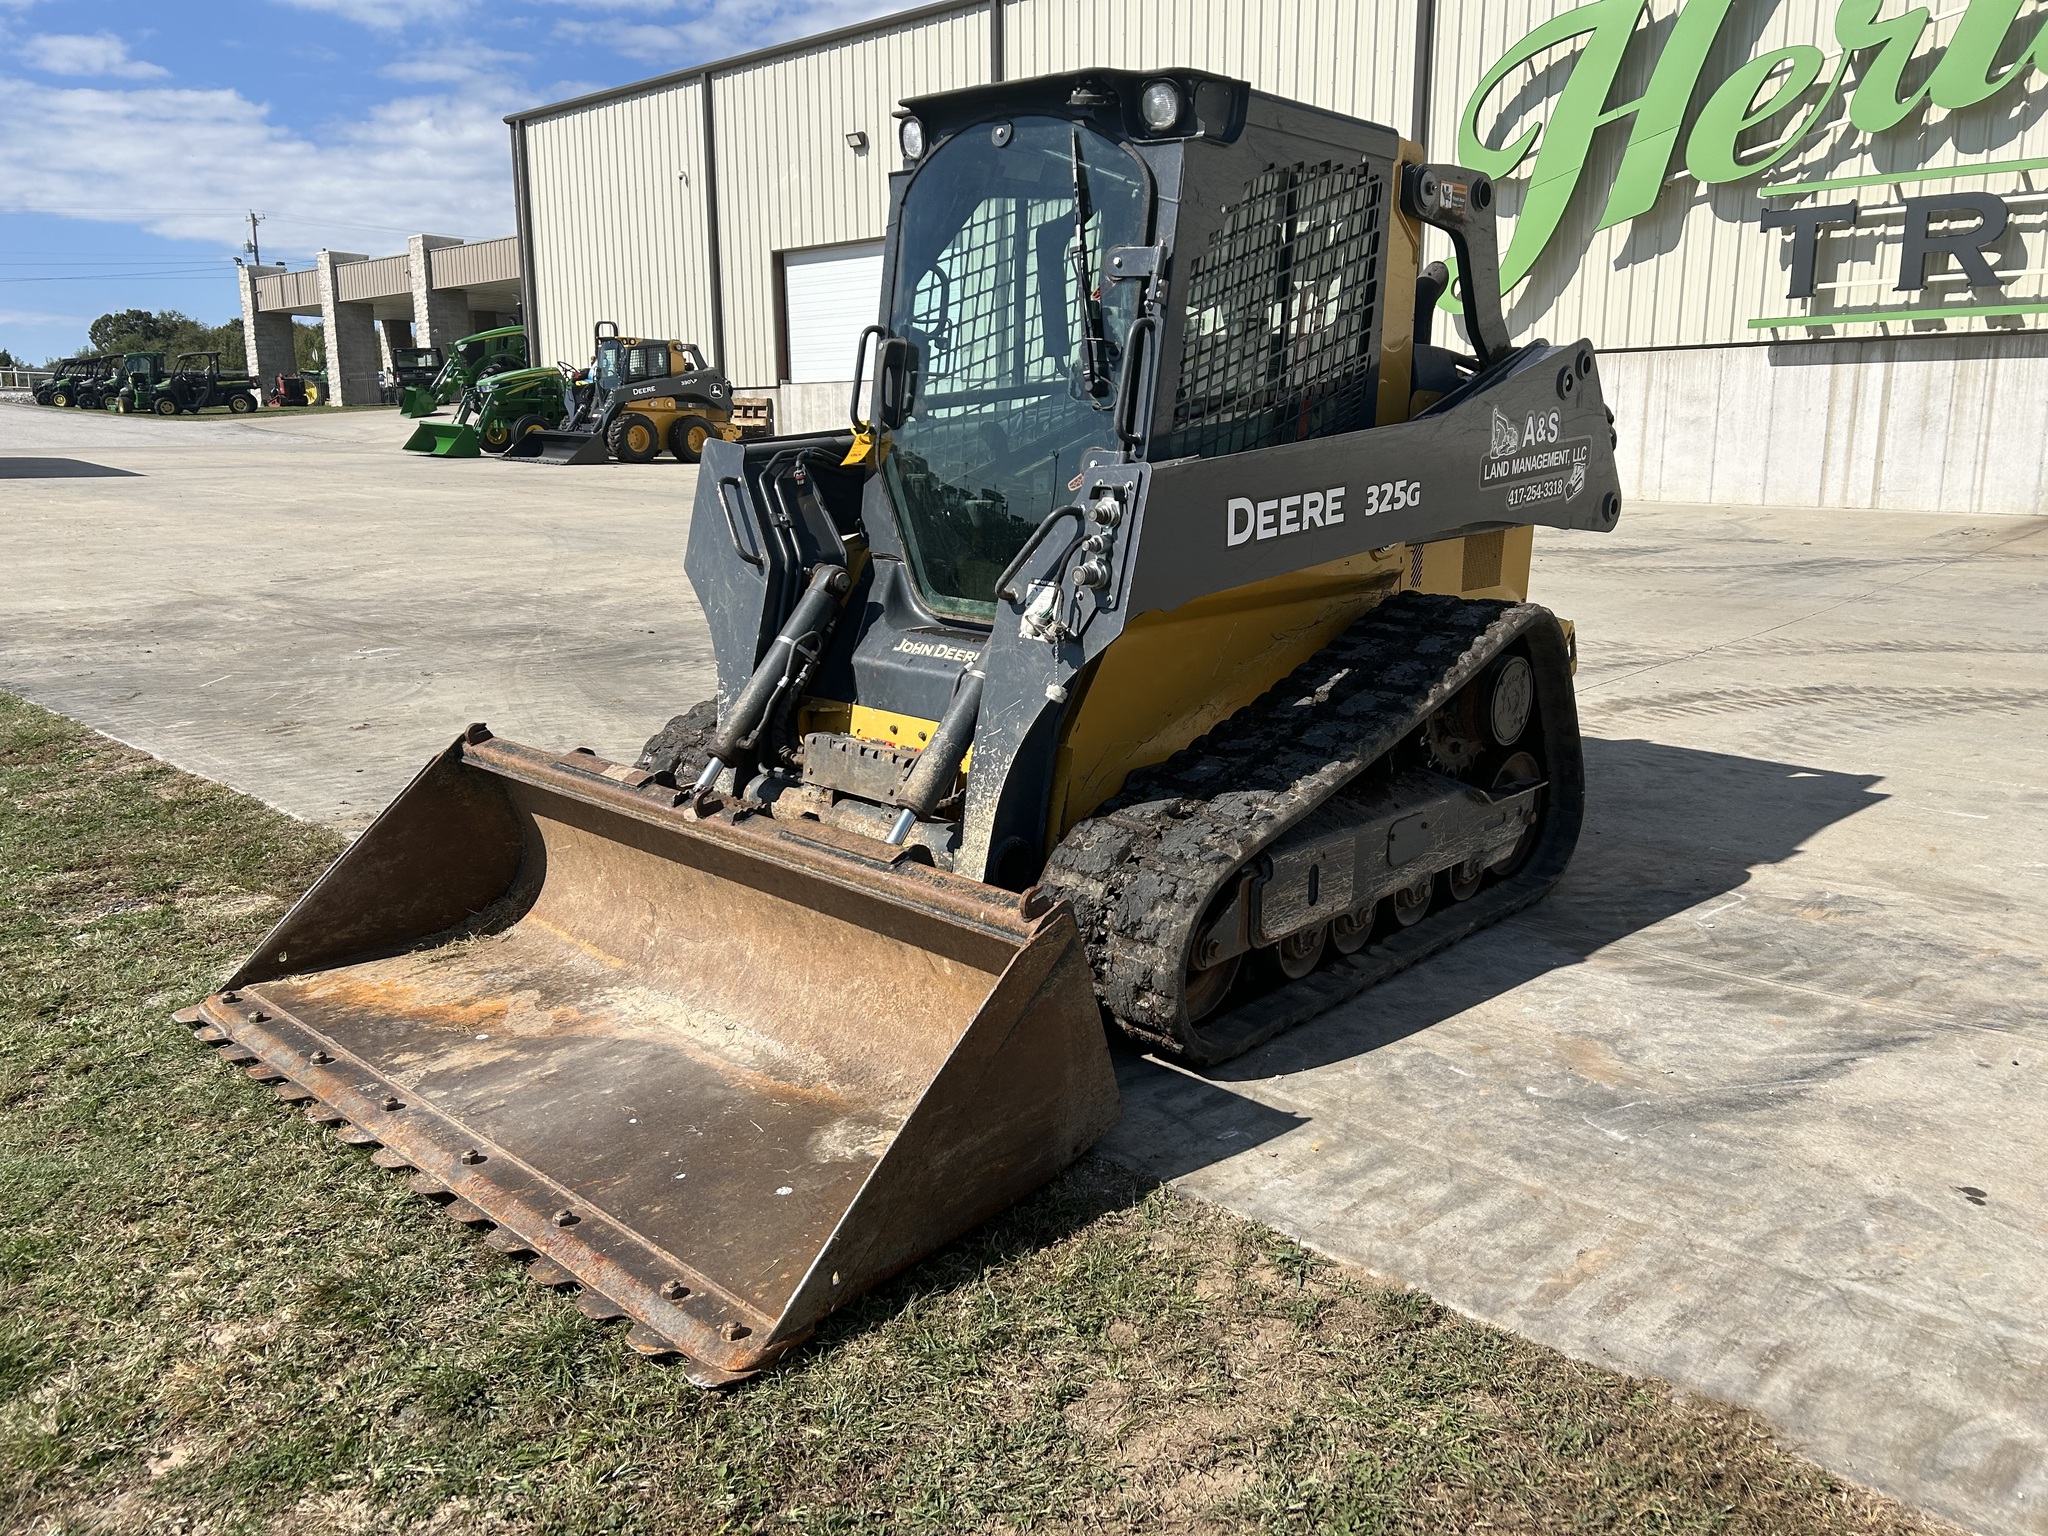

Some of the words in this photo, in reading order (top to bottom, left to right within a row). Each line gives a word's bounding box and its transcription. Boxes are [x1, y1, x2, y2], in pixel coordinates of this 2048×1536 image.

[1437, 0, 2048, 314] Heri
[632, 385, 656, 396] DEERE
[1522, 412, 1559, 448] A&S
[1484, 461, 1510, 481] LAND
[1511, 449, 1571, 475] MANAGEMENT,
[1572, 446, 1588, 463] LLC
[1508, 479, 1563, 506] 417-254-3318
[1227, 486, 1346, 547] DEERE
[1365, 479, 1421, 516] 325G
[892, 637, 935, 657] JOHN
